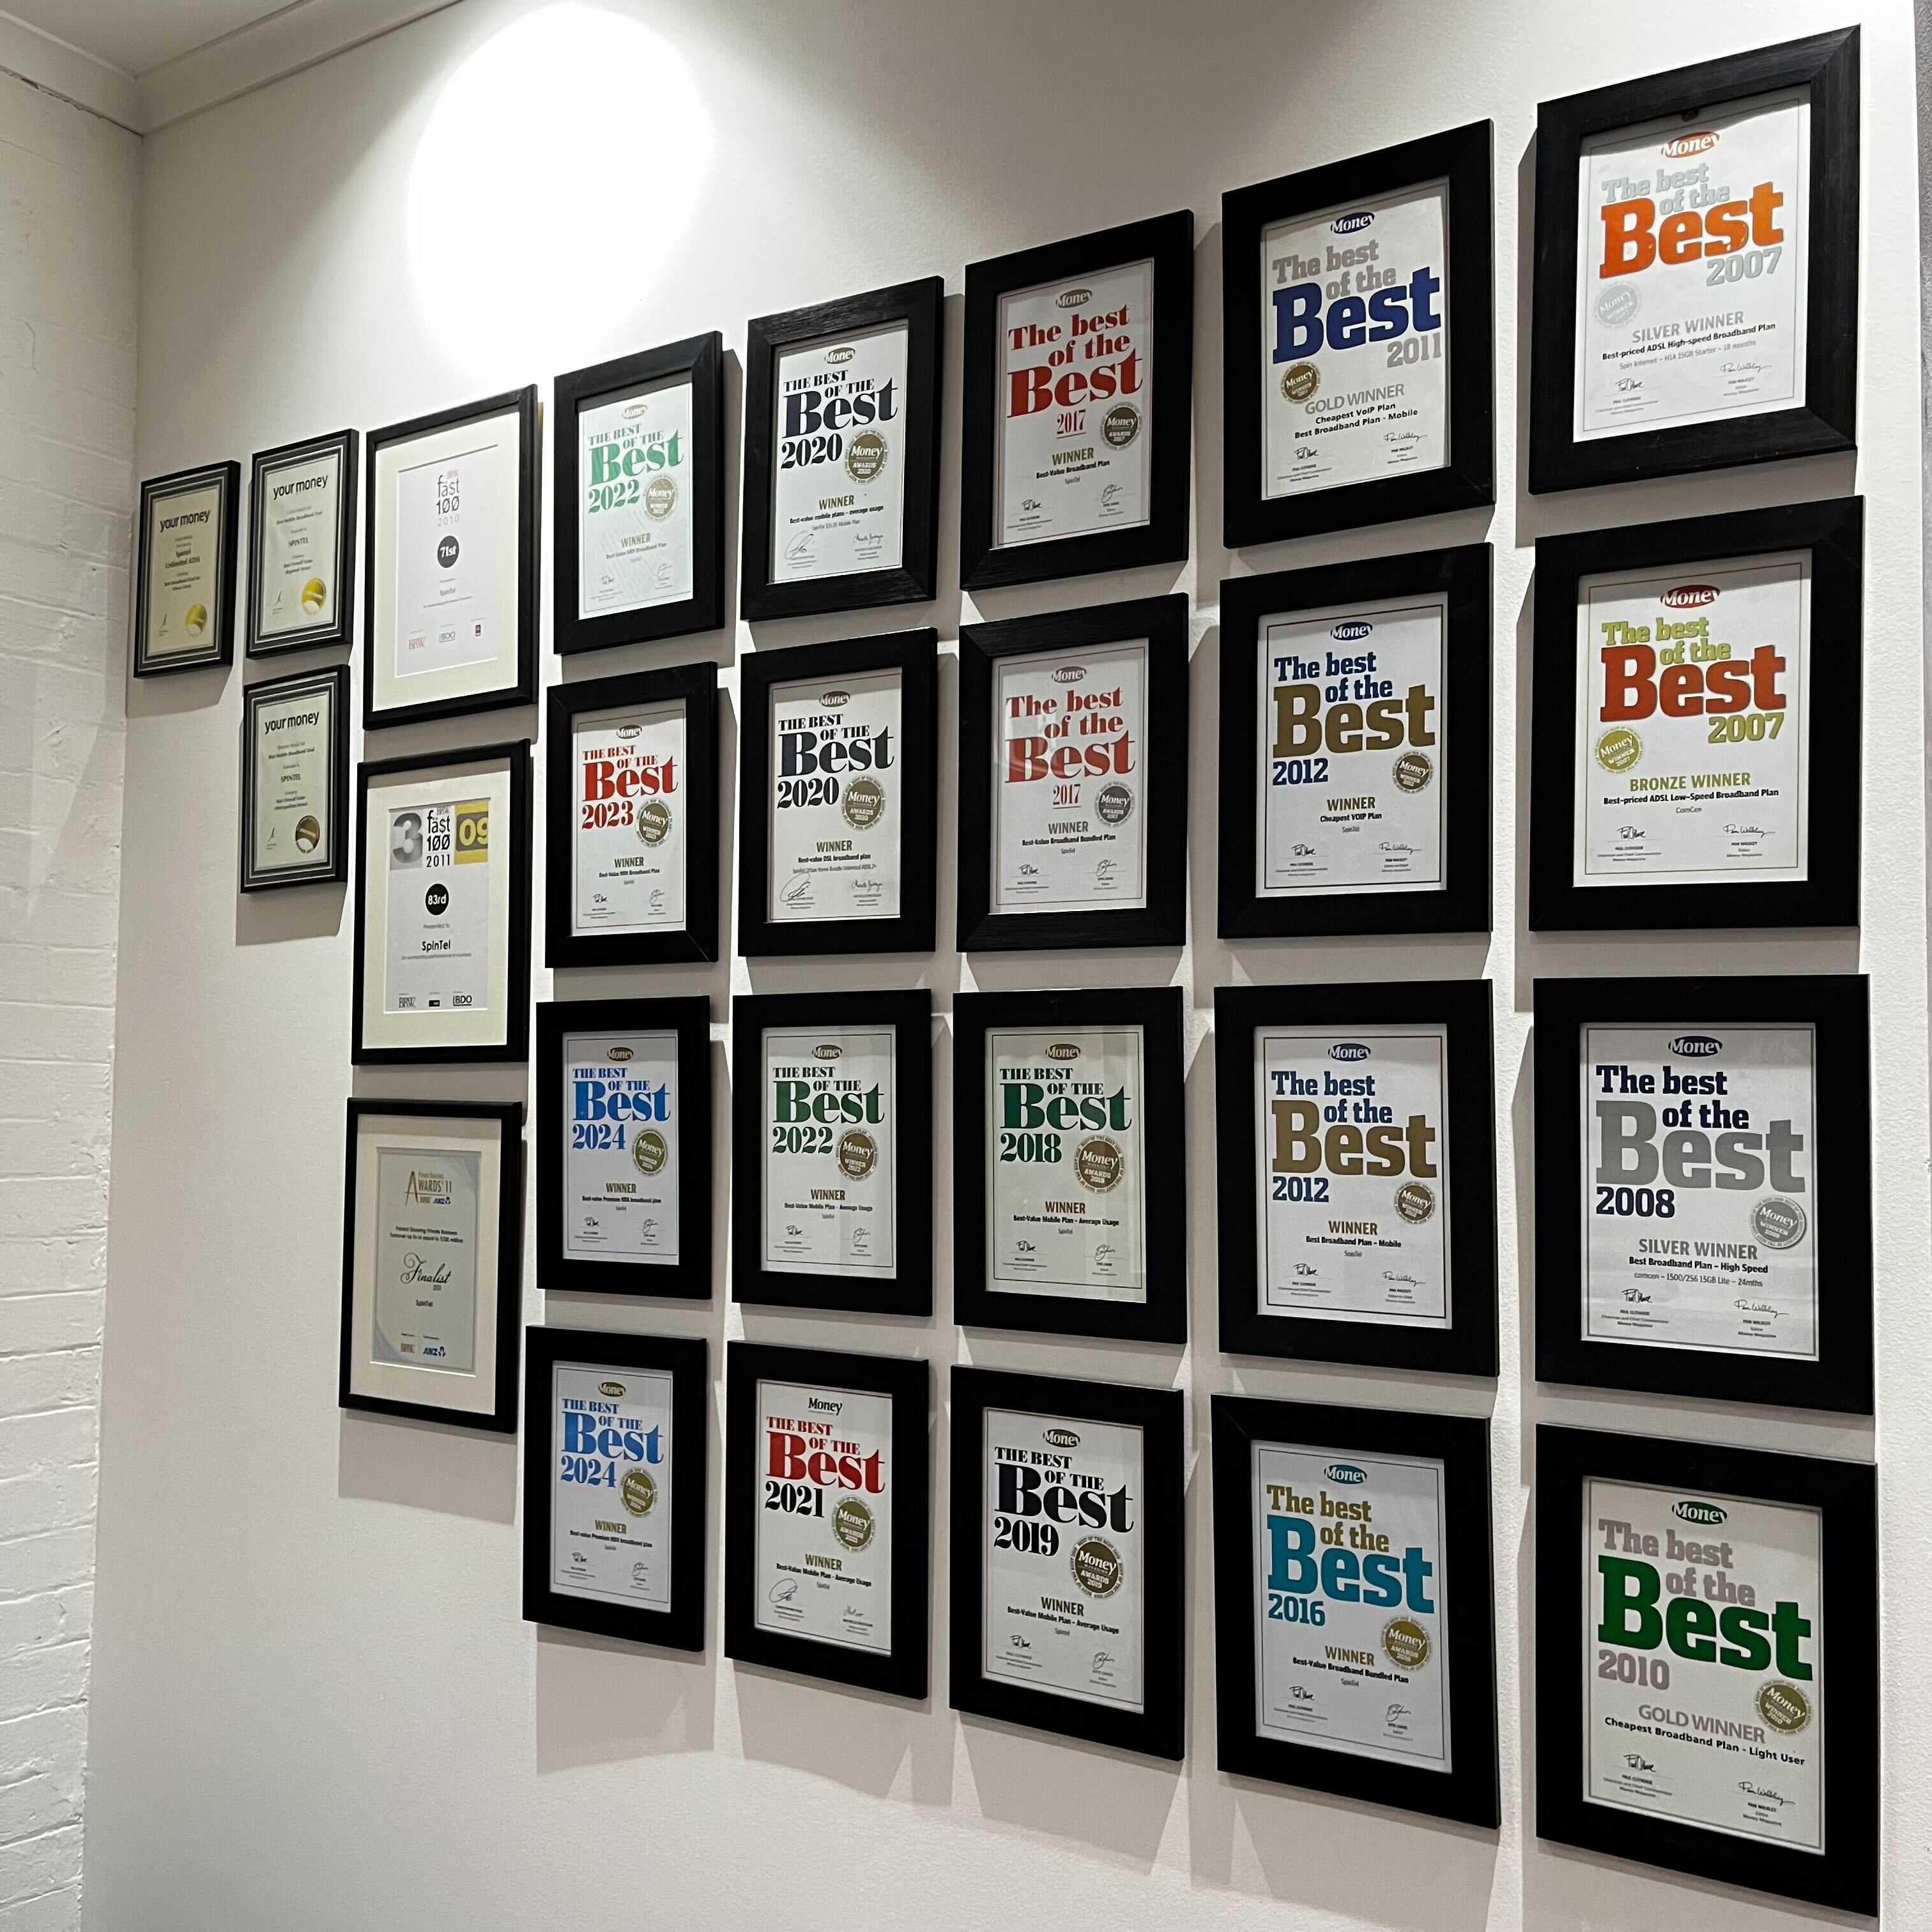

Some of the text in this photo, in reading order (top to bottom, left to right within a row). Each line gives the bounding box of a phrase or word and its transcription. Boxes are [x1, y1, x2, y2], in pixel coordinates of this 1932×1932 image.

[1600, 181, 1783, 279] Best
[1706, 247, 1782, 286] 2007
[1273, 266, 1441, 364] Best
[1632, 311, 1744, 344] SILVER WINNER
[1387, 333, 1441, 367] 2011
[1602, 323, 1775, 360] Best-priced ADSL High-speed Broadband Plan
[1007, 348, 1143, 418] Best
[782, 378, 898, 438] Best
[1305, 383, 1404, 415] GOLD WINNER
[1315, 411, 1354, 424] Cheapest
[1377, 404, 1395, 412] Plan
[1057, 410, 1085, 434] 2017
[1294, 409, 1418, 439] Best Broadband Plan Mobile
[588, 429, 684, 486] Best
[781, 433, 842, 470] 2020
[1052, 447, 1094, 466] WINNER
[588, 479, 640, 514] 2022
[819, 494, 854, 510] WINNER
[438, 514, 459, 527] 2010
[621, 532, 650, 548] WINNER
[1600, 645, 1786, 721] Best
[1273, 684, 1436, 758] Best
[1708, 712, 1784, 743] 2007
[778, 726, 894, 778] Best
[1005, 730, 1135, 783] Best
[582, 755, 678, 801] Best
[1273, 758, 1328, 786] 2012
[1630, 772, 1751, 792] BRONZE WINNER
[778, 777, 839, 809] 2020
[1053, 784, 1080, 805] 2017
[1326, 797, 1376, 811] WINNER
[1604, 788, 1779, 805] Best-priced ADSL Low-Speed Broadband Plan
[582, 801, 633, 829] 2023
[1048, 821, 1089, 834] WINNER
[426, 854, 450, 868] 2011
[816, 840, 852, 853] WINNER
[614, 856, 644, 868] WINNER
[428, 894, 447, 905] 83rd
[422, 940, 450, 953] SpinTel
[455, 995, 472, 1004] BDO
[1671, 1038, 1722, 1054] Money
[1596, 1065, 1728, 1095] The best
[572, 1083, 671, 1121] Best
[772, 1083, 884, 1124] Best
[1000, 1083, 1131, 1131] Best
[1662, 1100, 1749, 1129] of the
[572, 1124, 625, 1149] 2024
[772, 1126, 832, 1153] 2022
[1000, 1133, 1062, 1163] 2018
[1271, 1100, 1437, 1178] Best
[1596, 1100, 1805, 1193] Best
[606, 1183, 636, 1193] WINNER
[810, 1189, 845, 1200] WINNER
[1272, 1177, 1329, 1202] 2012
[1596, 1186, 1675, 1218] 2008
[1045, 1201, 1085, 1215] WINNER
[1321, 1236, 1356, 1245] Broadband
[1379, 1239, 1402, 1248] Mobile
[1328, 1220, 1378, 1236] WINNER
[1639, 1238, 1758, 1260] SILVER WINNER
[401, 1252, 451, 1285] Finalist
[1629, 1256, 1768, 1273] Best Broadband Plan High Speed
[562, 1425, 664, 1464] Best
[561, 1456, 617, 1487] 2024
[766, 1450, 885, 1493] Best
[765, 1481, 824, 1517] 2021
[994, 1462, 1133, 1533] Best
[595, 1519, 627, 1535] WINNER
[994, 1517, 1059, 1556] 2019
[805, 1553, 842, 1571] WINNER
[1267, 1514, 1434, 1614] Best
[1041, 1597, 1084, 1617] WINNER
[1268, 1593, 1325, 1626] 2016
[1598, 1554, 1813, 1682] Best
[1324, 1645, 1375, 1666] WINNER
[1598, 1649, 1669, 1690] 2010
[1638, 1705, 1765, 1744] GOLD WINNER
[1605, 1717, 1805, 1765] Cheapest Broadband Plan Light User
